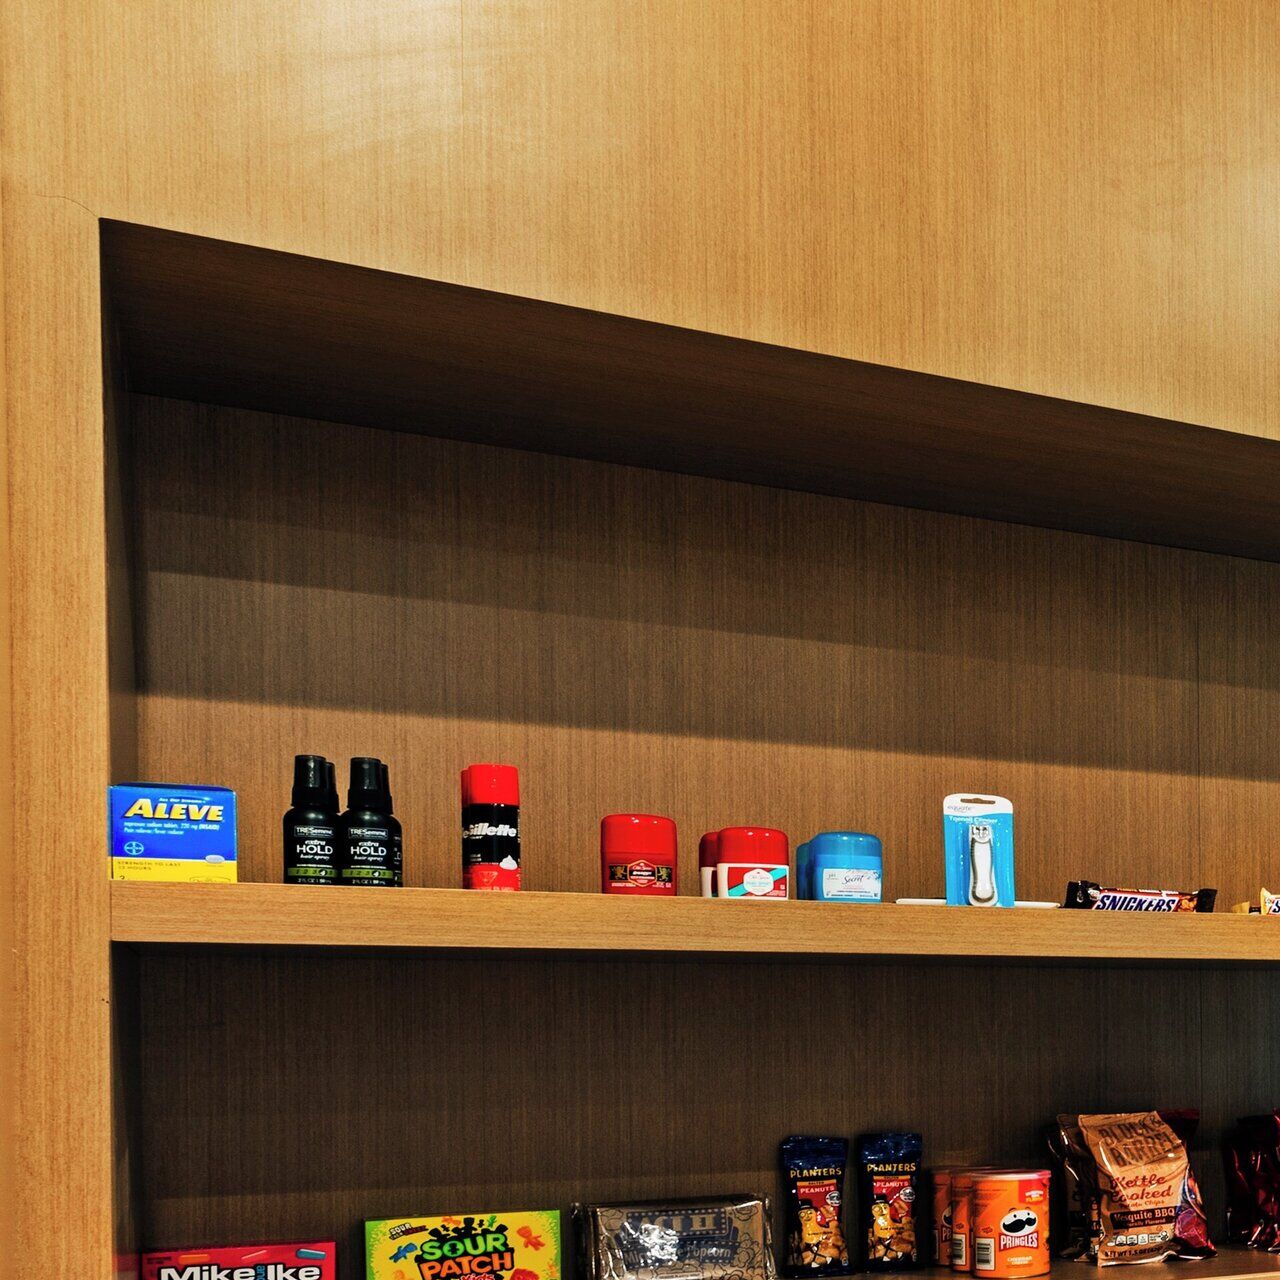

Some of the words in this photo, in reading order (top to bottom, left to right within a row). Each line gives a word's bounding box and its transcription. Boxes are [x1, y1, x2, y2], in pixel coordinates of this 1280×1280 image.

[124, 798, 224, 821] ALEVE
[296, 845, 333, 854] HOLD
[351, 846, 387, 855] HOLD
[842, 875, 865, 885] Secret
[1096, 895, 1176, 912] SNICKERS
[790, 1167, 842, 1179] PLANTERS
[867, 1162, 916, 1173] PLANTERS
[1112, 1173, 1166, 1190] Kettle
[800, 1185, 836, 1194] PEANUTS
[1154, 1207, 1175, 1218] BBQ
[390, 1224, 412, 1235] SOUR
[422, 1233, 506, 1261] SOUR
[1000, 1233, 1038, 1250] PRINGLES
